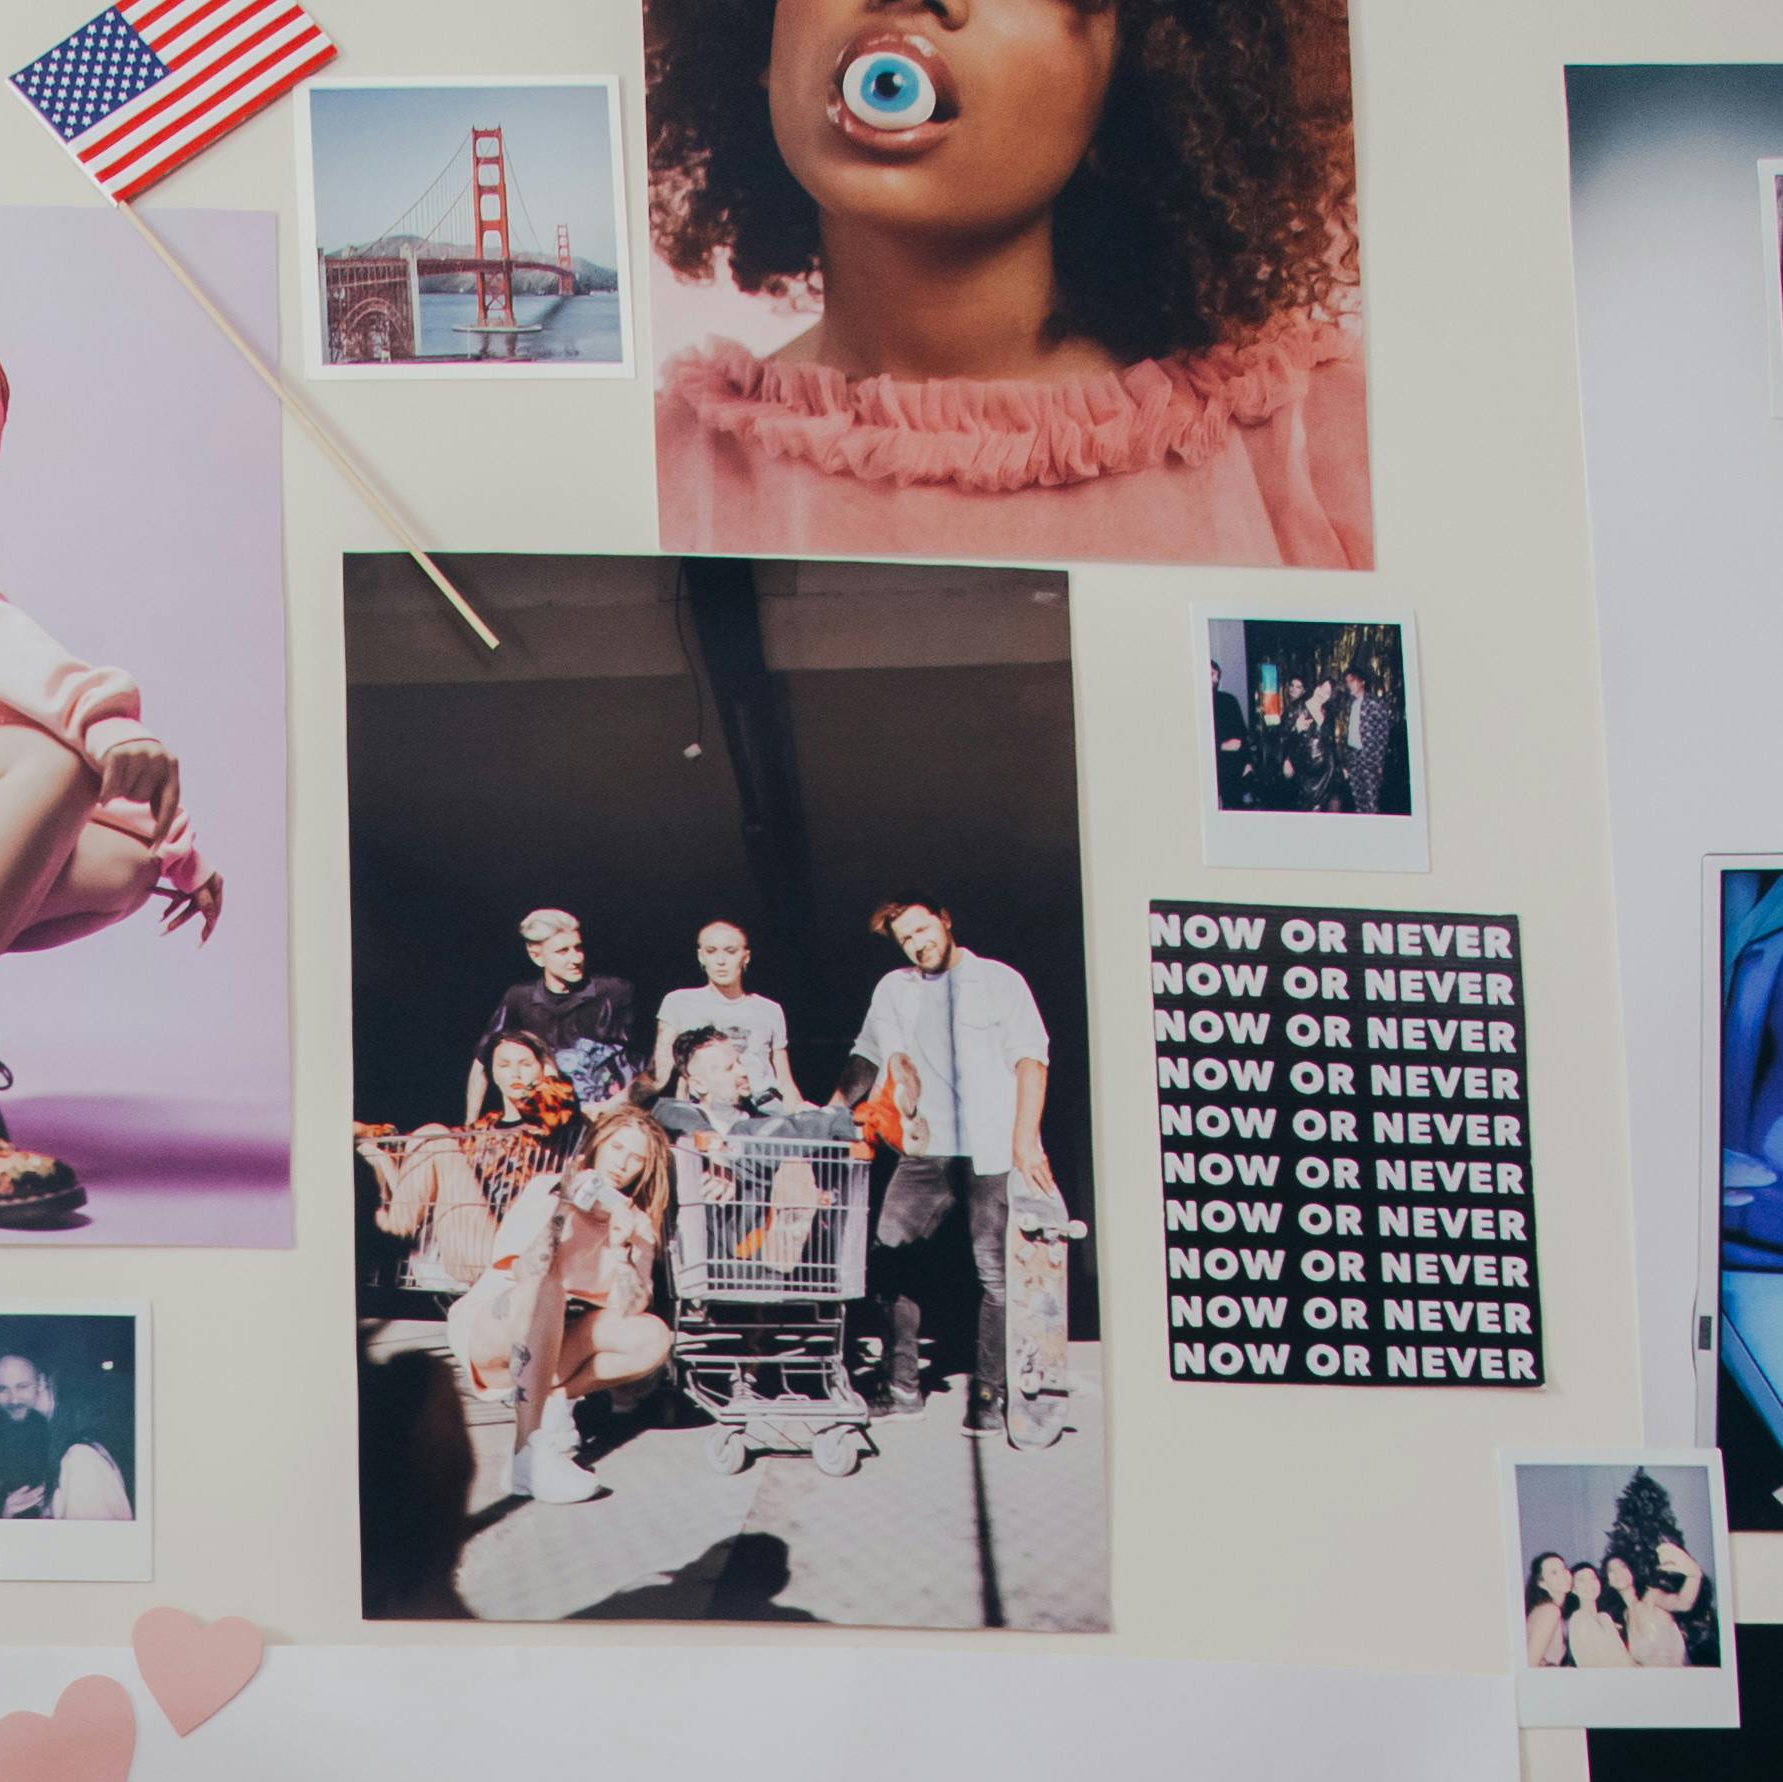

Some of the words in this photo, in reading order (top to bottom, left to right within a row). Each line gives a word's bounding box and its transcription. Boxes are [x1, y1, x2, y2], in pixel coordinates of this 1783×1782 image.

[1151, 914, 1266, 951] NOW
[1281, 919, 1347, 952] OR
[1362, 922, 1512, 958] NEVER
[1153, 961, 1269, 998] NOW
[1283, 966, 1349, 999] OR
[1365, 969, 1514, 1005] NEVER
[1156, 1009, 1272, 1046] NOW
[1286, 1014, 1351, 1047] OR
[1368, 1017, 1516, 1053] NEVER
[1158, 1056, 1274, 1093] NOW
[1290, 1062, 1355, 1094] OR
[1371, 1065, 1519, 1099] NEVER
[1161, 1104, 1277, 1140] NOW
[1293, 1110, 1358, 1141] OR
[1374, 1112, 1521, 1146] NEVER
[1163, 1152, 1280, 1187] NOW
[1296, 1157, 1360, 1188] OR
[1376, 1160, 1524, 1194] NEVER
[1166, 1199, 1283, 1234] NOW
[1299, 1204, 1363, 1235] OR
[1379, 1206, 1526, 1240] NEVER
[1168, 1247, 1285, 1281] NOW
[1301, 1250, 1365, 1281] OR
[1381, 1253, 1529, 1287] NEVER
[1171, 1295, 1288, 1328] NOW
[1304, 1298, 1368, 1329] OR
[1384, 1300, 1532, 1334] NEVER
[1173, 1342, 1291, 1375] NOW
[1306, 1344, 1371, 1376] OR
[1387, 1346, 1536, 1379] NEVER
